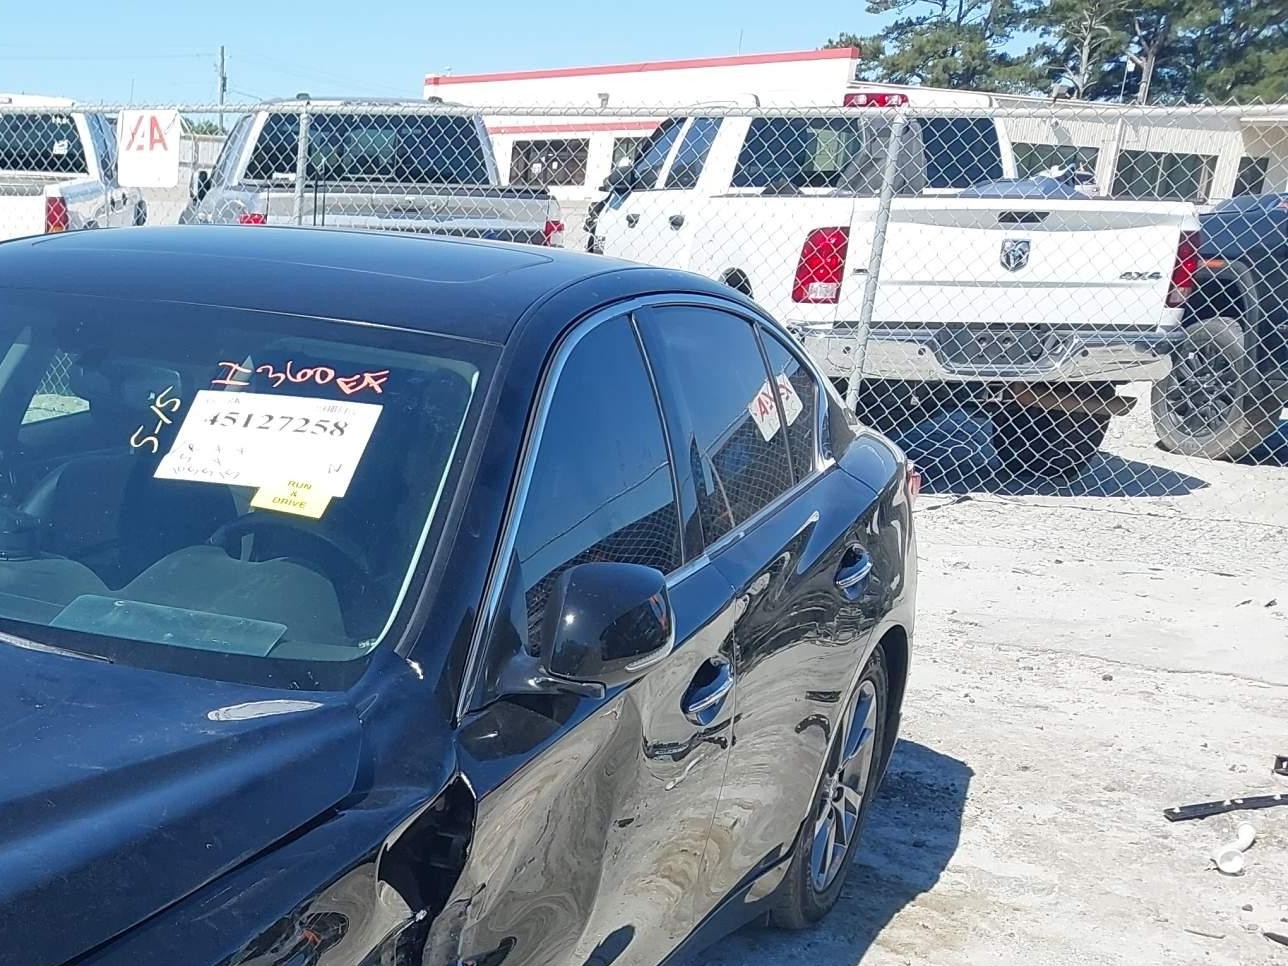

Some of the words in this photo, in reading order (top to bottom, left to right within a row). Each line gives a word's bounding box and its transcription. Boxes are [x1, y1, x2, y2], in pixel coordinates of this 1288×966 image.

[203, 411, 349, 438] 45127258
[287, 480, 313, 490] RUN
[272, 496, 307, 509] DRIVE
